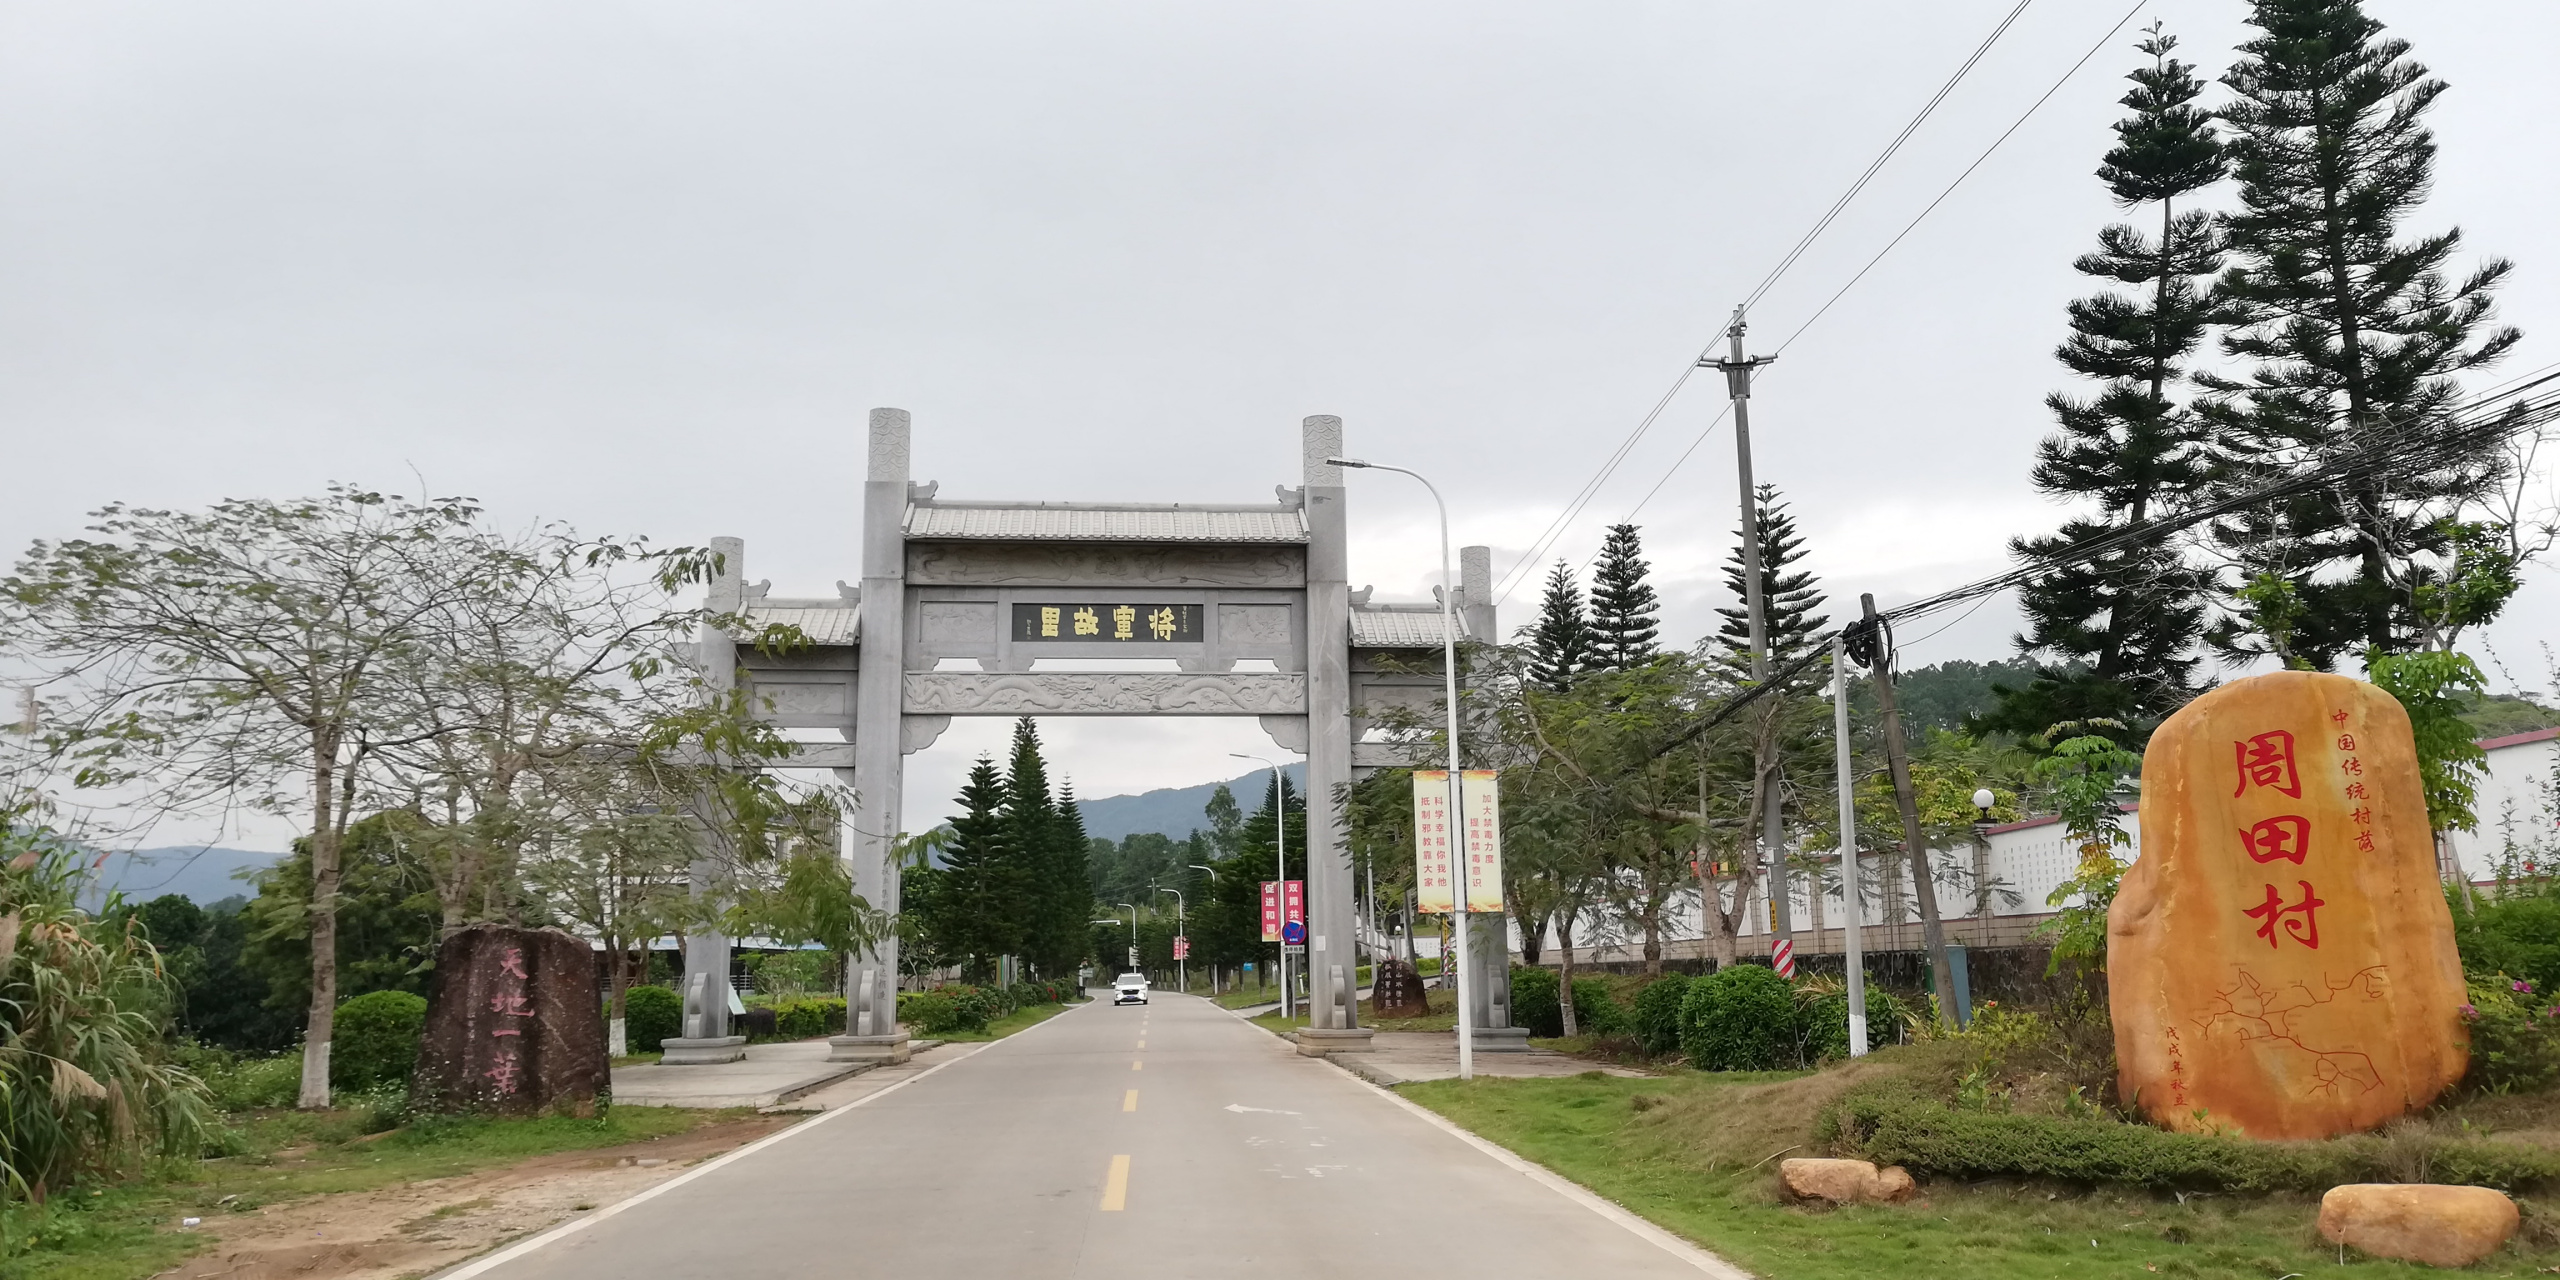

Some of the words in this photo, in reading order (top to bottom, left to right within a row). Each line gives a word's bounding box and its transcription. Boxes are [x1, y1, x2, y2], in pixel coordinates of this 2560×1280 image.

[2331, 708, 2375, 853] 中国传统村落
[1421, 796, 1433, 887] 抵制邪教靠大家
[1434, 796, 1447, 887] 科学幸福你我他
[1470, 817, 1482, 887] 提高禁毒意识
[1482, 794, 1495, 864] 加大禁毒力度
[2233, 729, 2326, 950] 周田村
